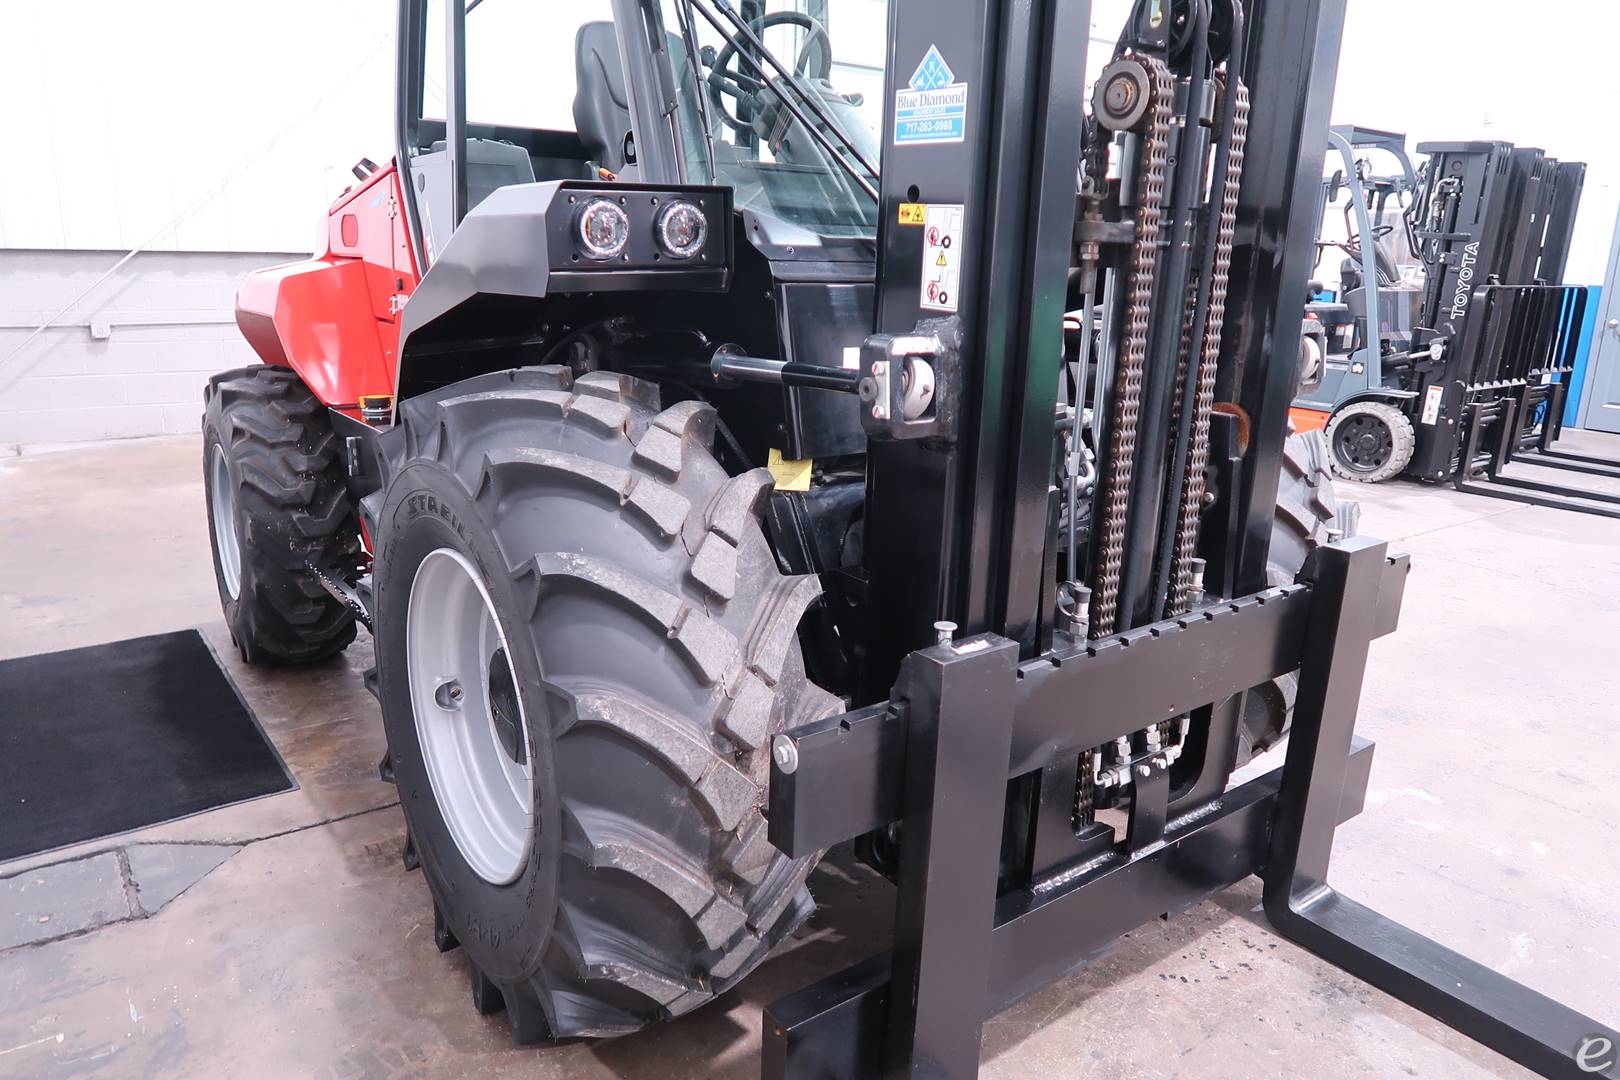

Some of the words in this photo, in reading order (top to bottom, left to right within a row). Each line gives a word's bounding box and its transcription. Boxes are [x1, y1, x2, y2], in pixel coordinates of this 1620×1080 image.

[897, 95, 918, 109] Blue
[919, 90, 965, 107] Diamond
[905, 119, 953, 133] 717-263-0988
[1450, 241, 1480, 320] TOYOTA
